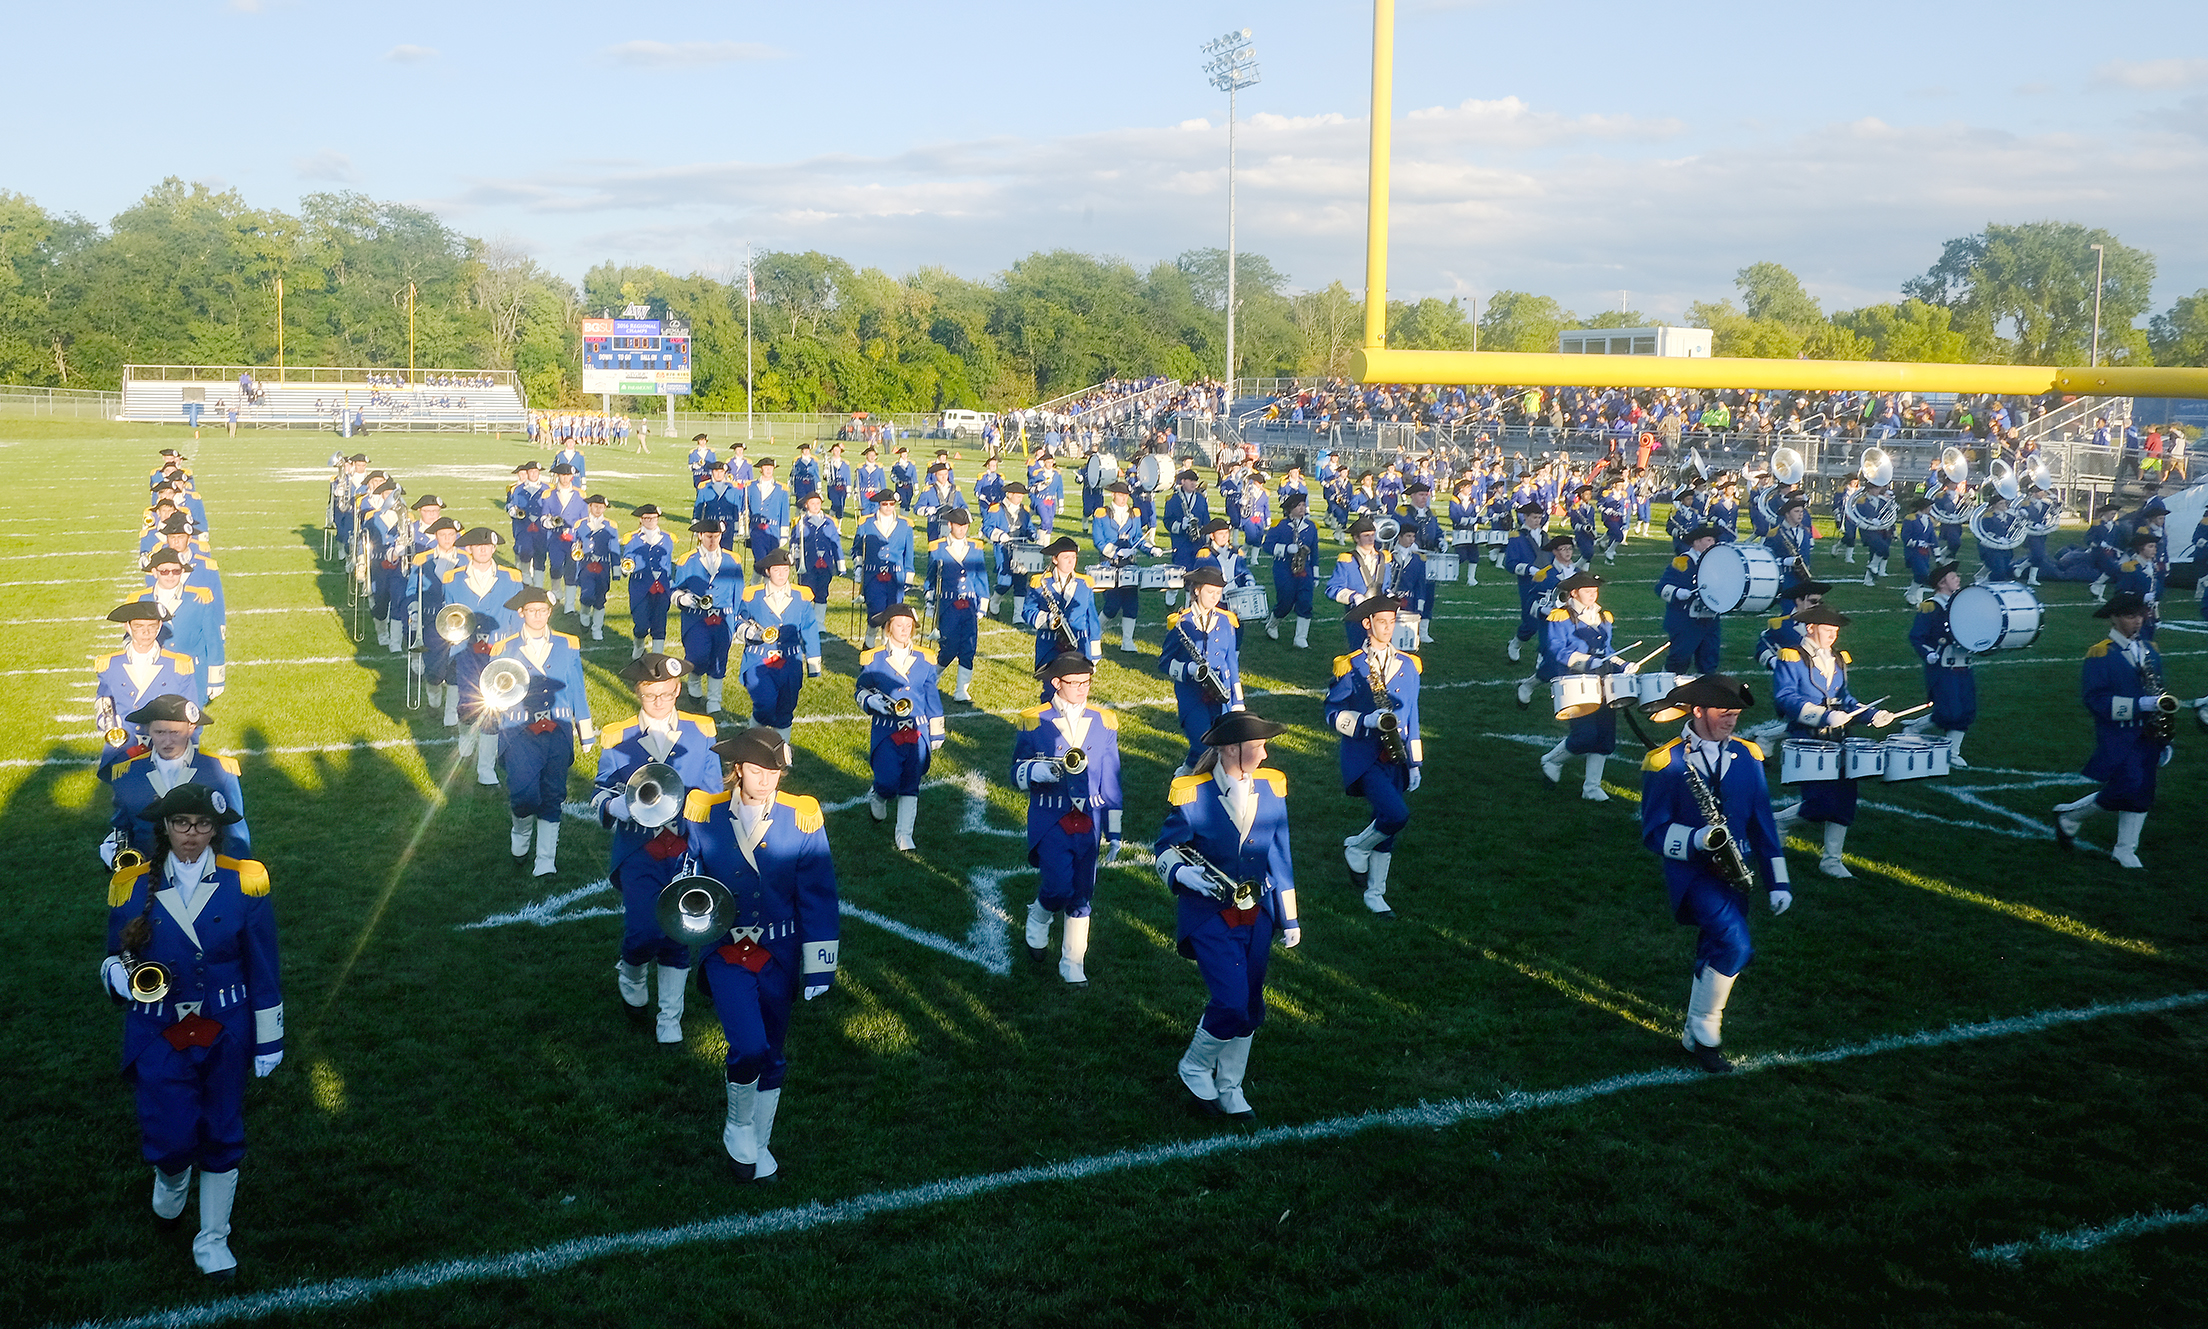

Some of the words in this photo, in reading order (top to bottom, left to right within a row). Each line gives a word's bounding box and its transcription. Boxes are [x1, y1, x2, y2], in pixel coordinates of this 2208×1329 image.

[623, 302, 651, 320] AW
[584, 322, 612, 333] BGSU
[1669, 840, 1682, 856] AW
[818, 948, 835, 965] AW
